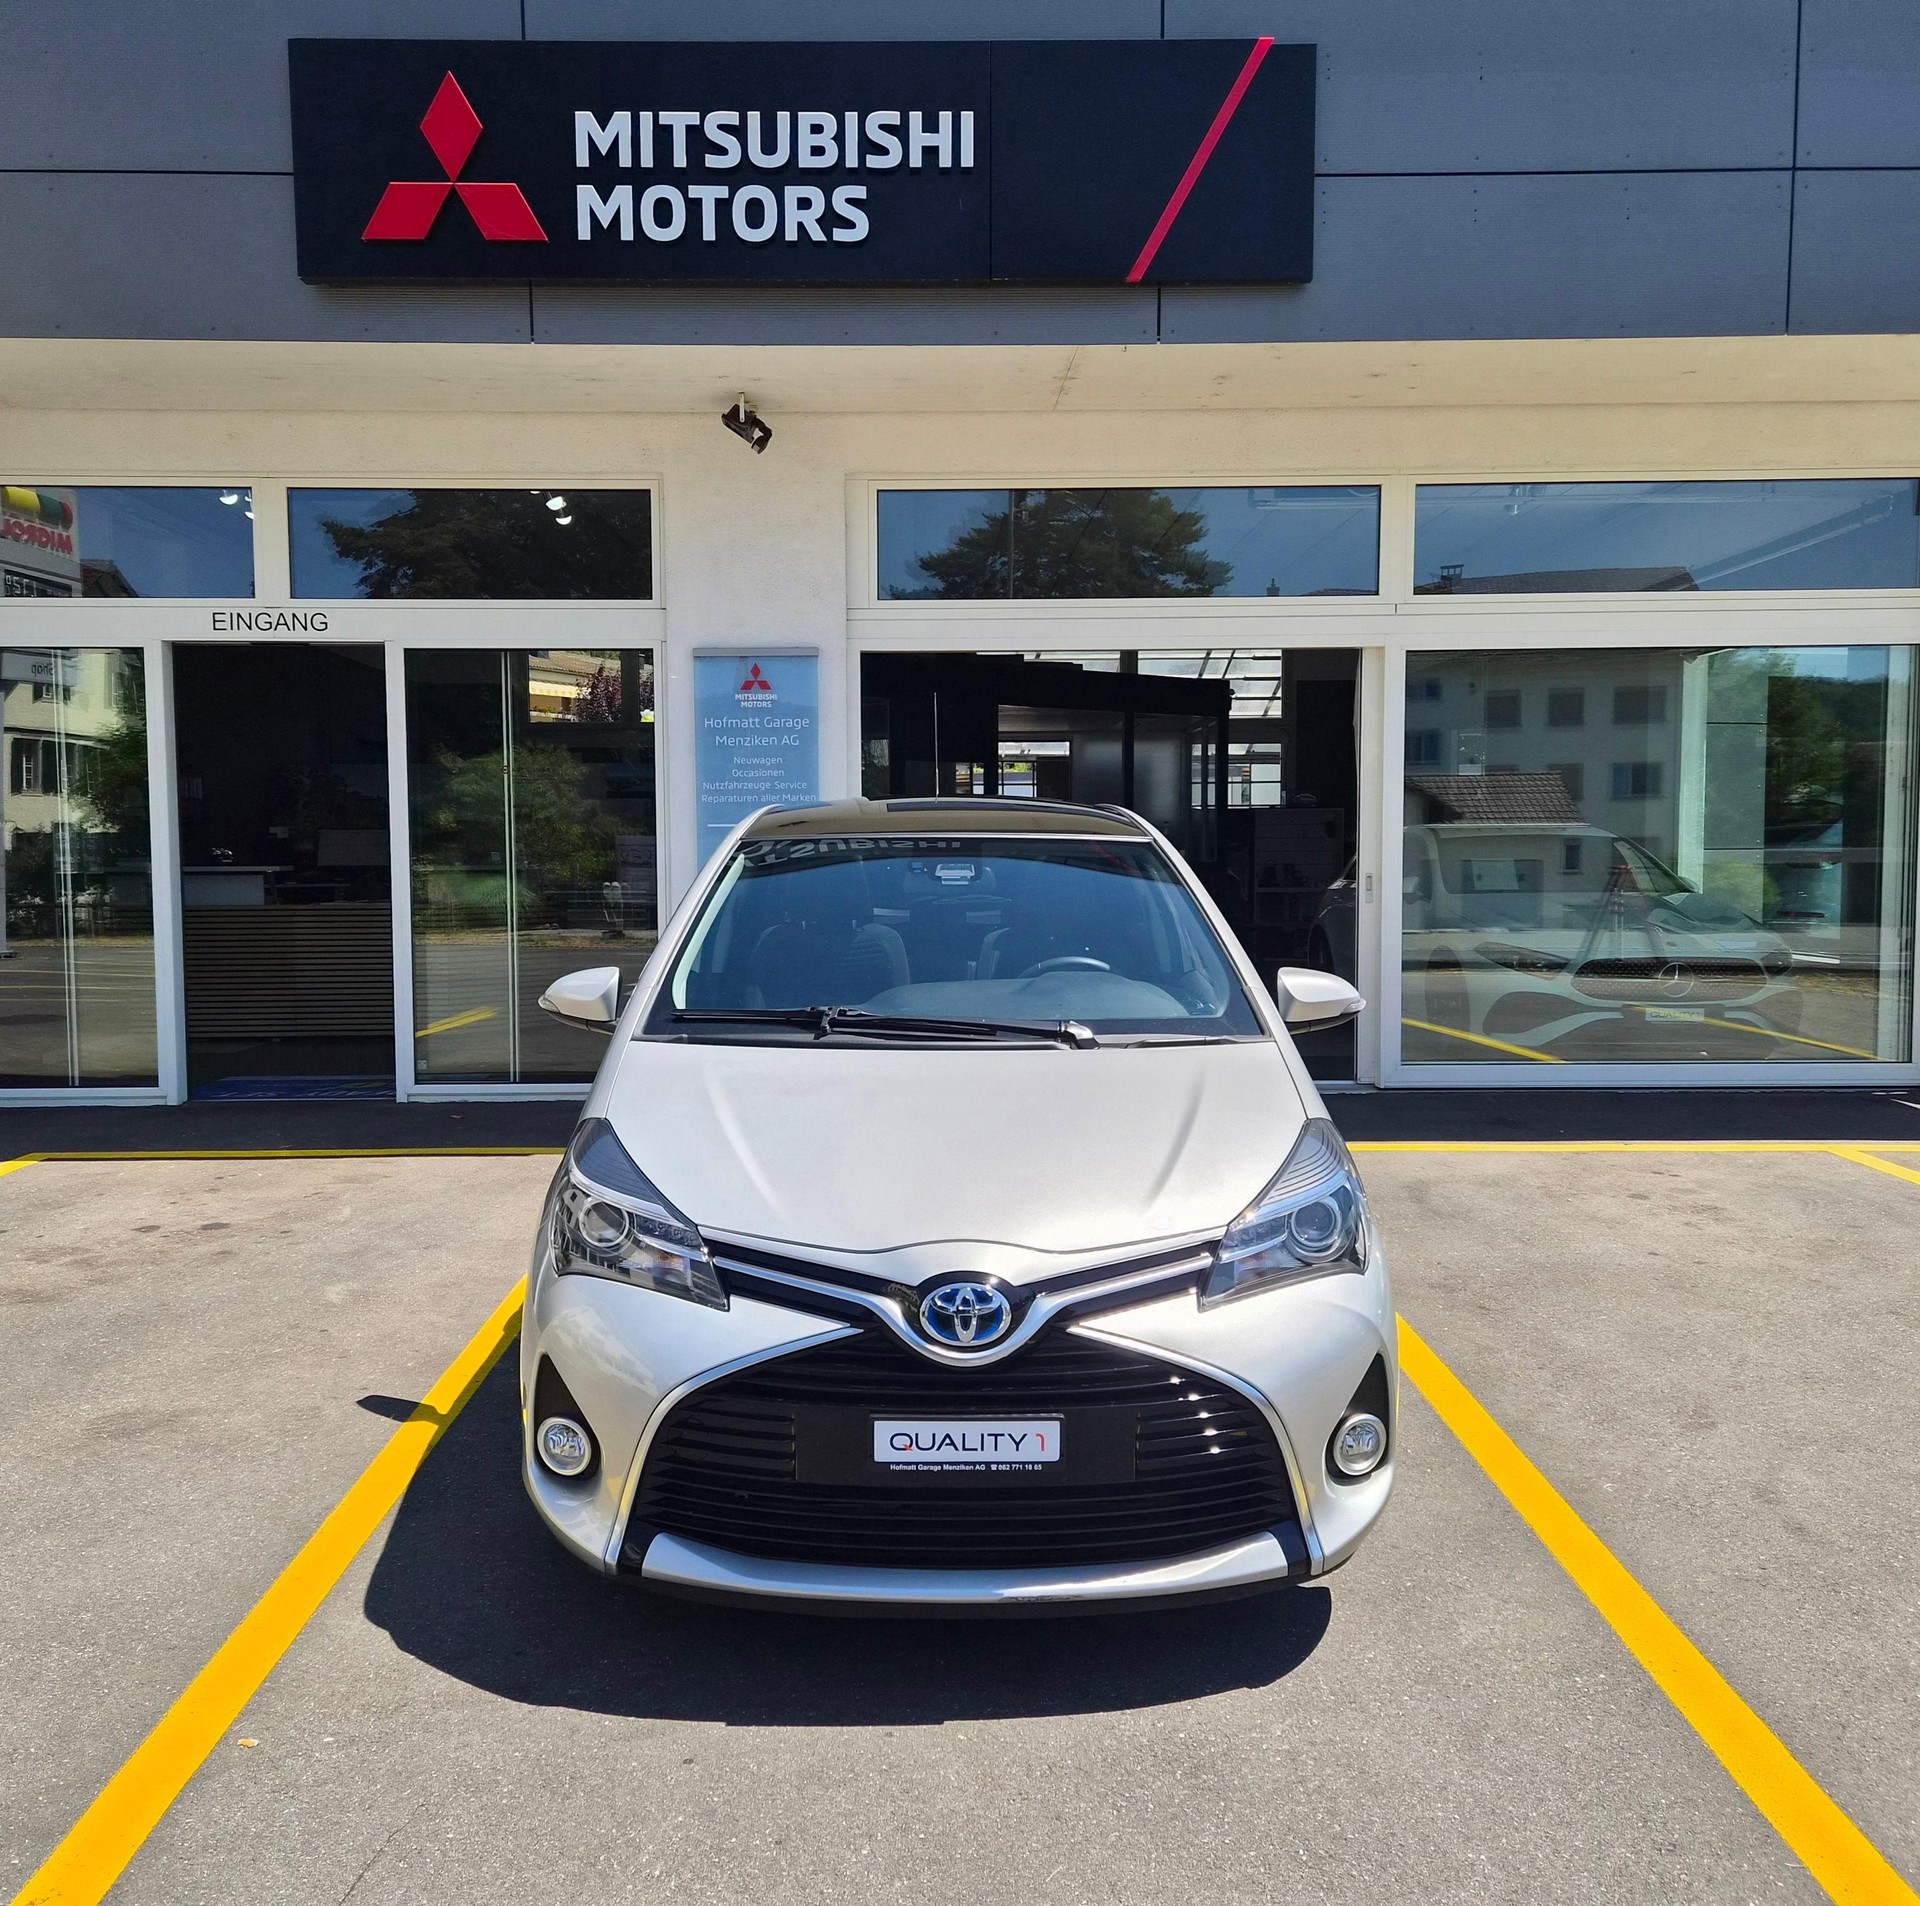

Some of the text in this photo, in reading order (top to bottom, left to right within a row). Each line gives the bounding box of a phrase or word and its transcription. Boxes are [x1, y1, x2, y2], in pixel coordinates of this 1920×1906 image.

[574, 110, 975, 170] MITSUBISHI
[576, 184, 871, 243] MOTORS
[212, 612, 329, 632] EINGANG
[734, 693, 778, 701] MITSUBISHI
[740, 700, 772, 708] MOTORS
[704, 716, 810, 730] Hofmatt Garage
[715, 735, 800, 747] Menziken AG
[733, 756, 783, 767] Neuwagen
[731, 768, 785, 778] Occasionen
[702, 781, 808, 790] Nutzfahrzeuge Service
[701, 794, 818, 803] Reparaturen aller Marken
[889, 1432, 1047, 1452] QUALITY 1
[917, 1464, 942, 1472] Garage
